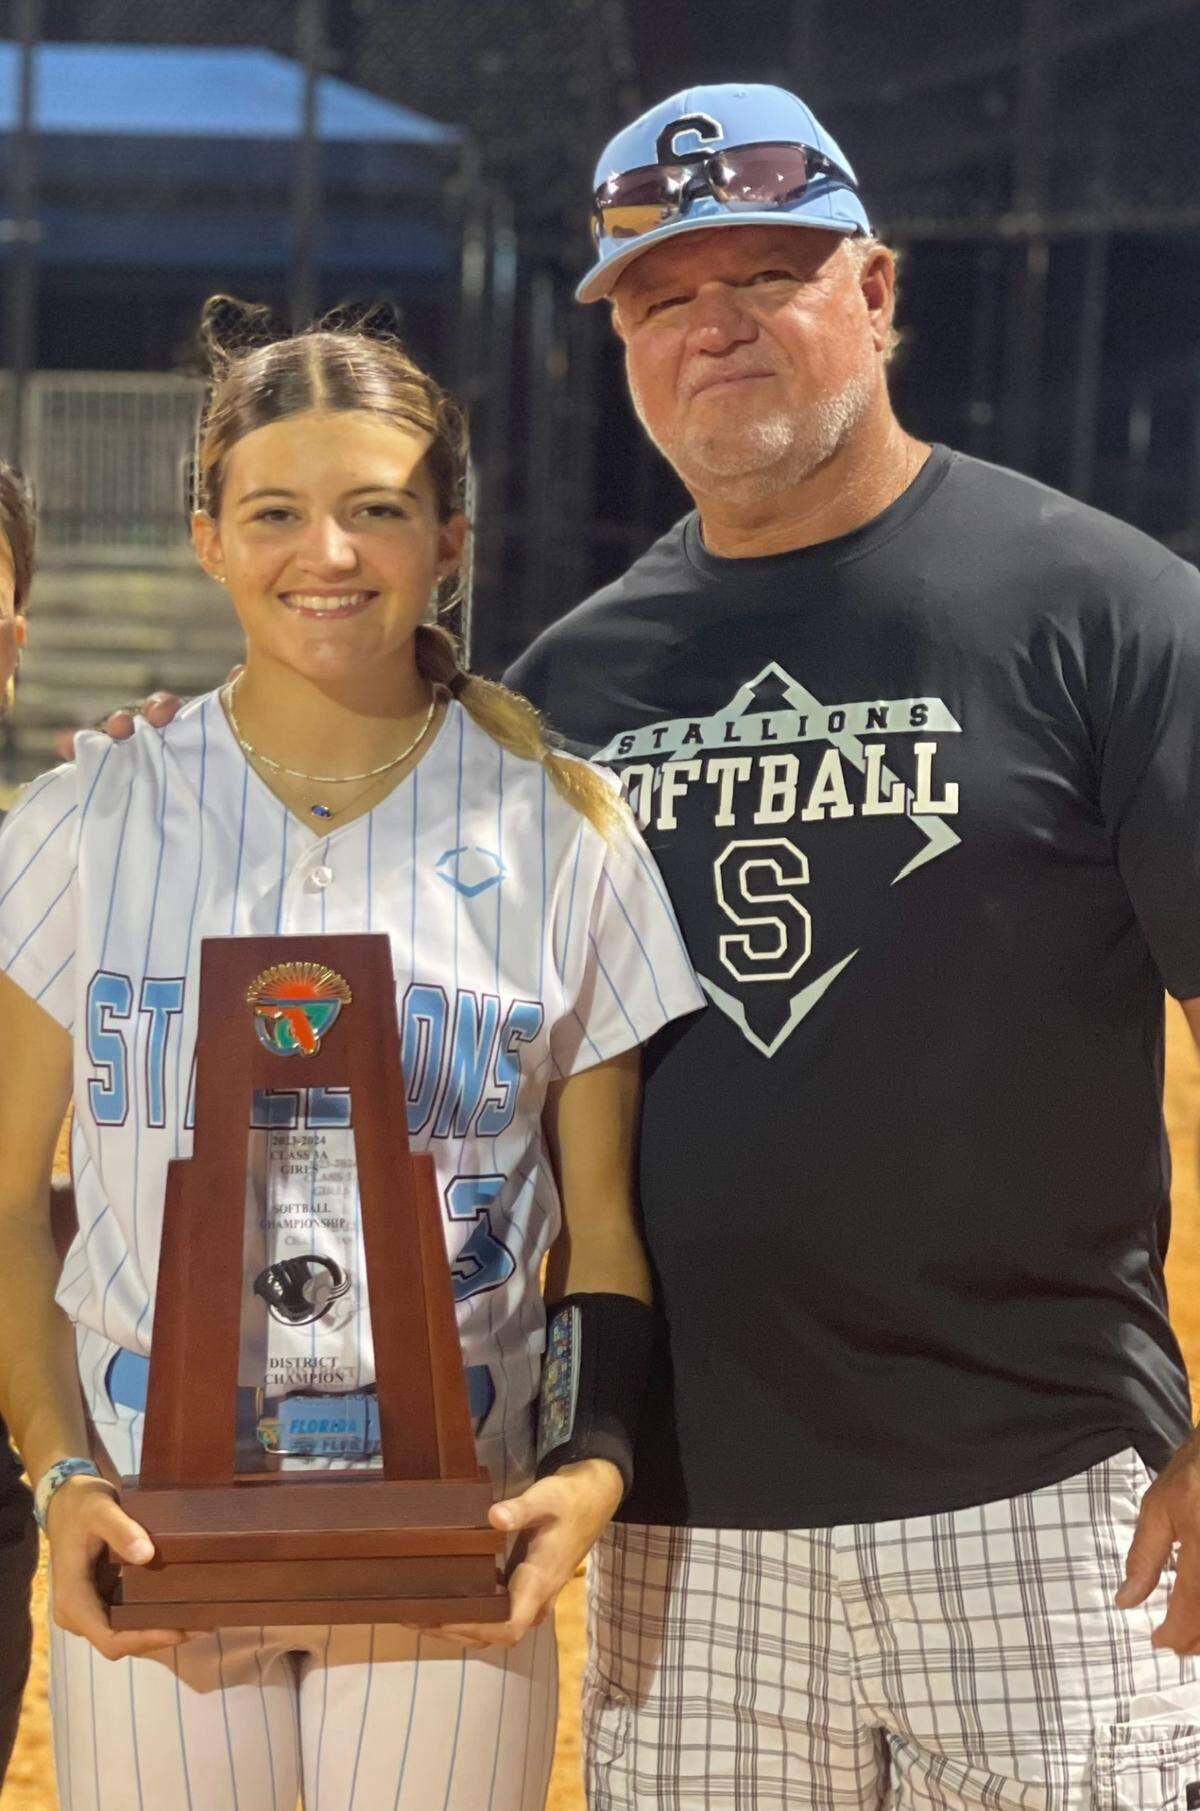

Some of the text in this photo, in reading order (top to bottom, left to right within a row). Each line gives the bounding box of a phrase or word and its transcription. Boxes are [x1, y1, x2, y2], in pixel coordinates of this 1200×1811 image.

[618, 703, 928, 755] STALLIONS
[619, 742, 959, 831] OFTBALL
[714, 837, 812, 982] S
[270, 1151, 310, 1161] CLASS
[272, 1202, 331, 1214] SOFTBALL
[259, 1217, 346, 1229] CHAMPIONSHIP
[269, 1356, 338, 1369] DISTRICT
[264, 1372, 344, 1385] CHAMPION
